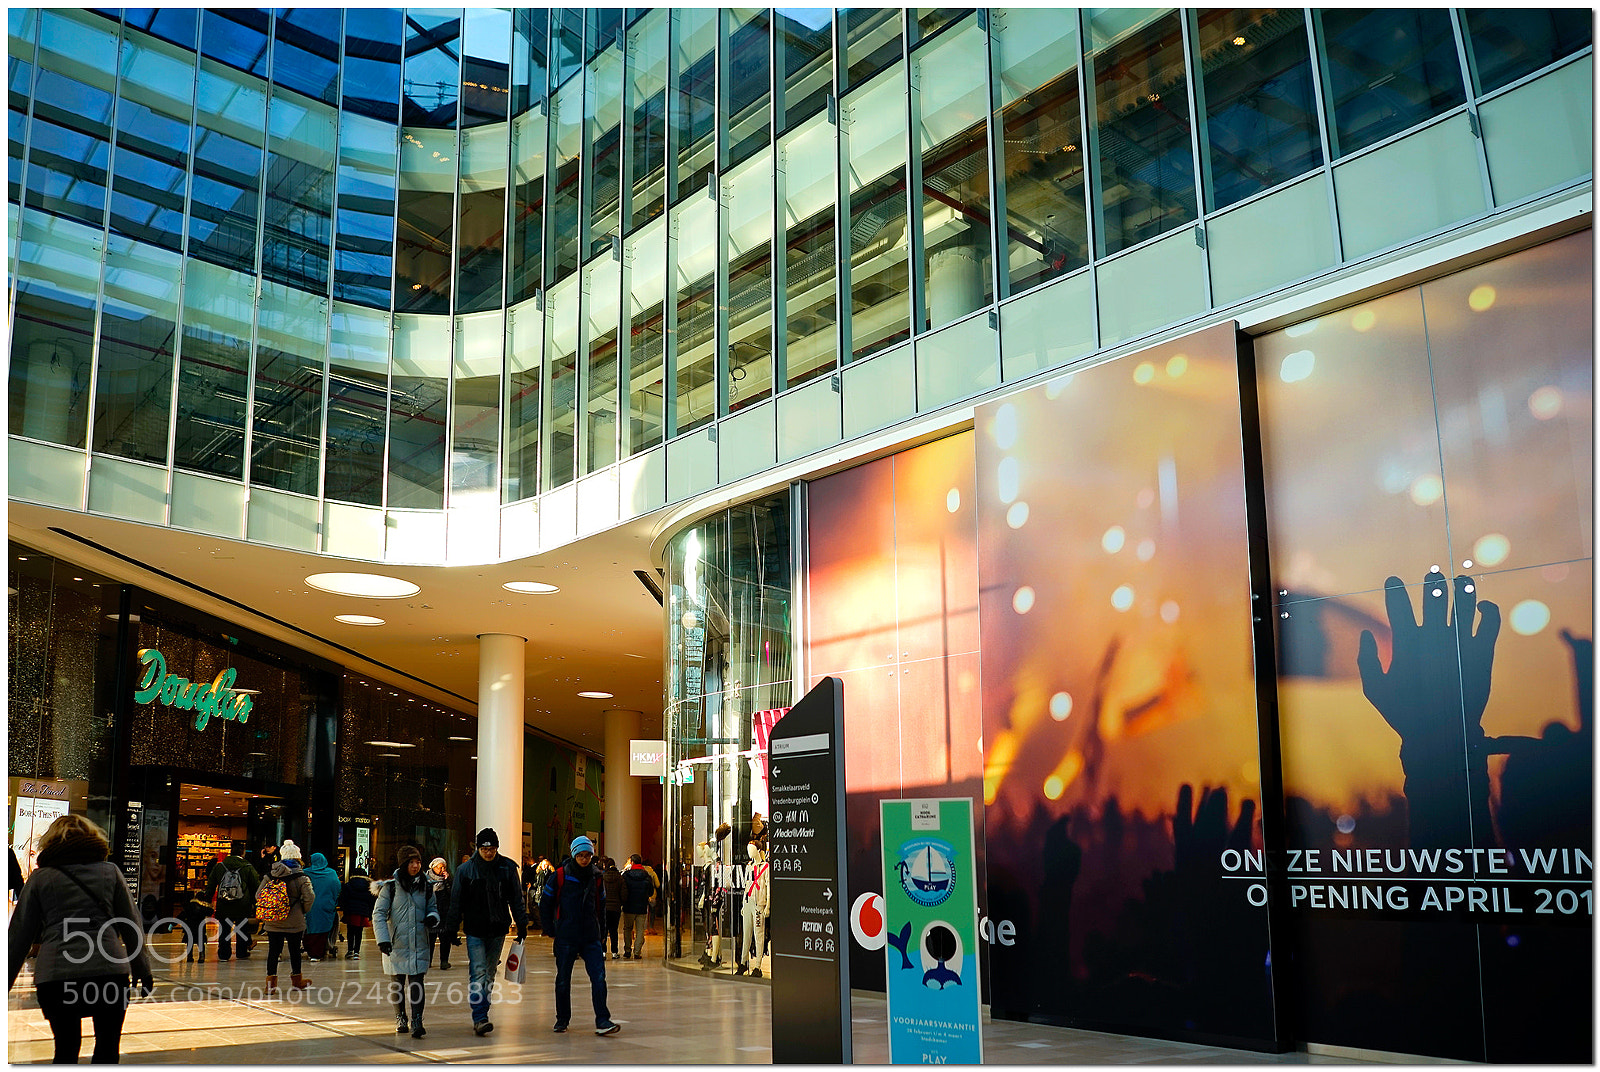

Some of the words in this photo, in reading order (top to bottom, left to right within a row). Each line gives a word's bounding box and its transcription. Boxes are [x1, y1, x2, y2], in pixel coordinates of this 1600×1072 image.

[134, 648, 253, 731] Douglas
[39, 784, 67, 796] Faced
[772, 783, 811, 792] Smakkelaarsveld
[772, 796, 811, 805] Vredenburgplein
[773, 844, 808, 854] ZARA
[1331, 848, 1508, 874] NIEUWSTE
[1420, 886, 1523, 913] APRIL
[800, 906, 834, 916] Moreelsepark
[801, 921, 823, 933] ACTION
[893, 1016, 976, 1032] VOORJAARSVAKANTIE
[922, 1053, 947, 1064] PLAY
